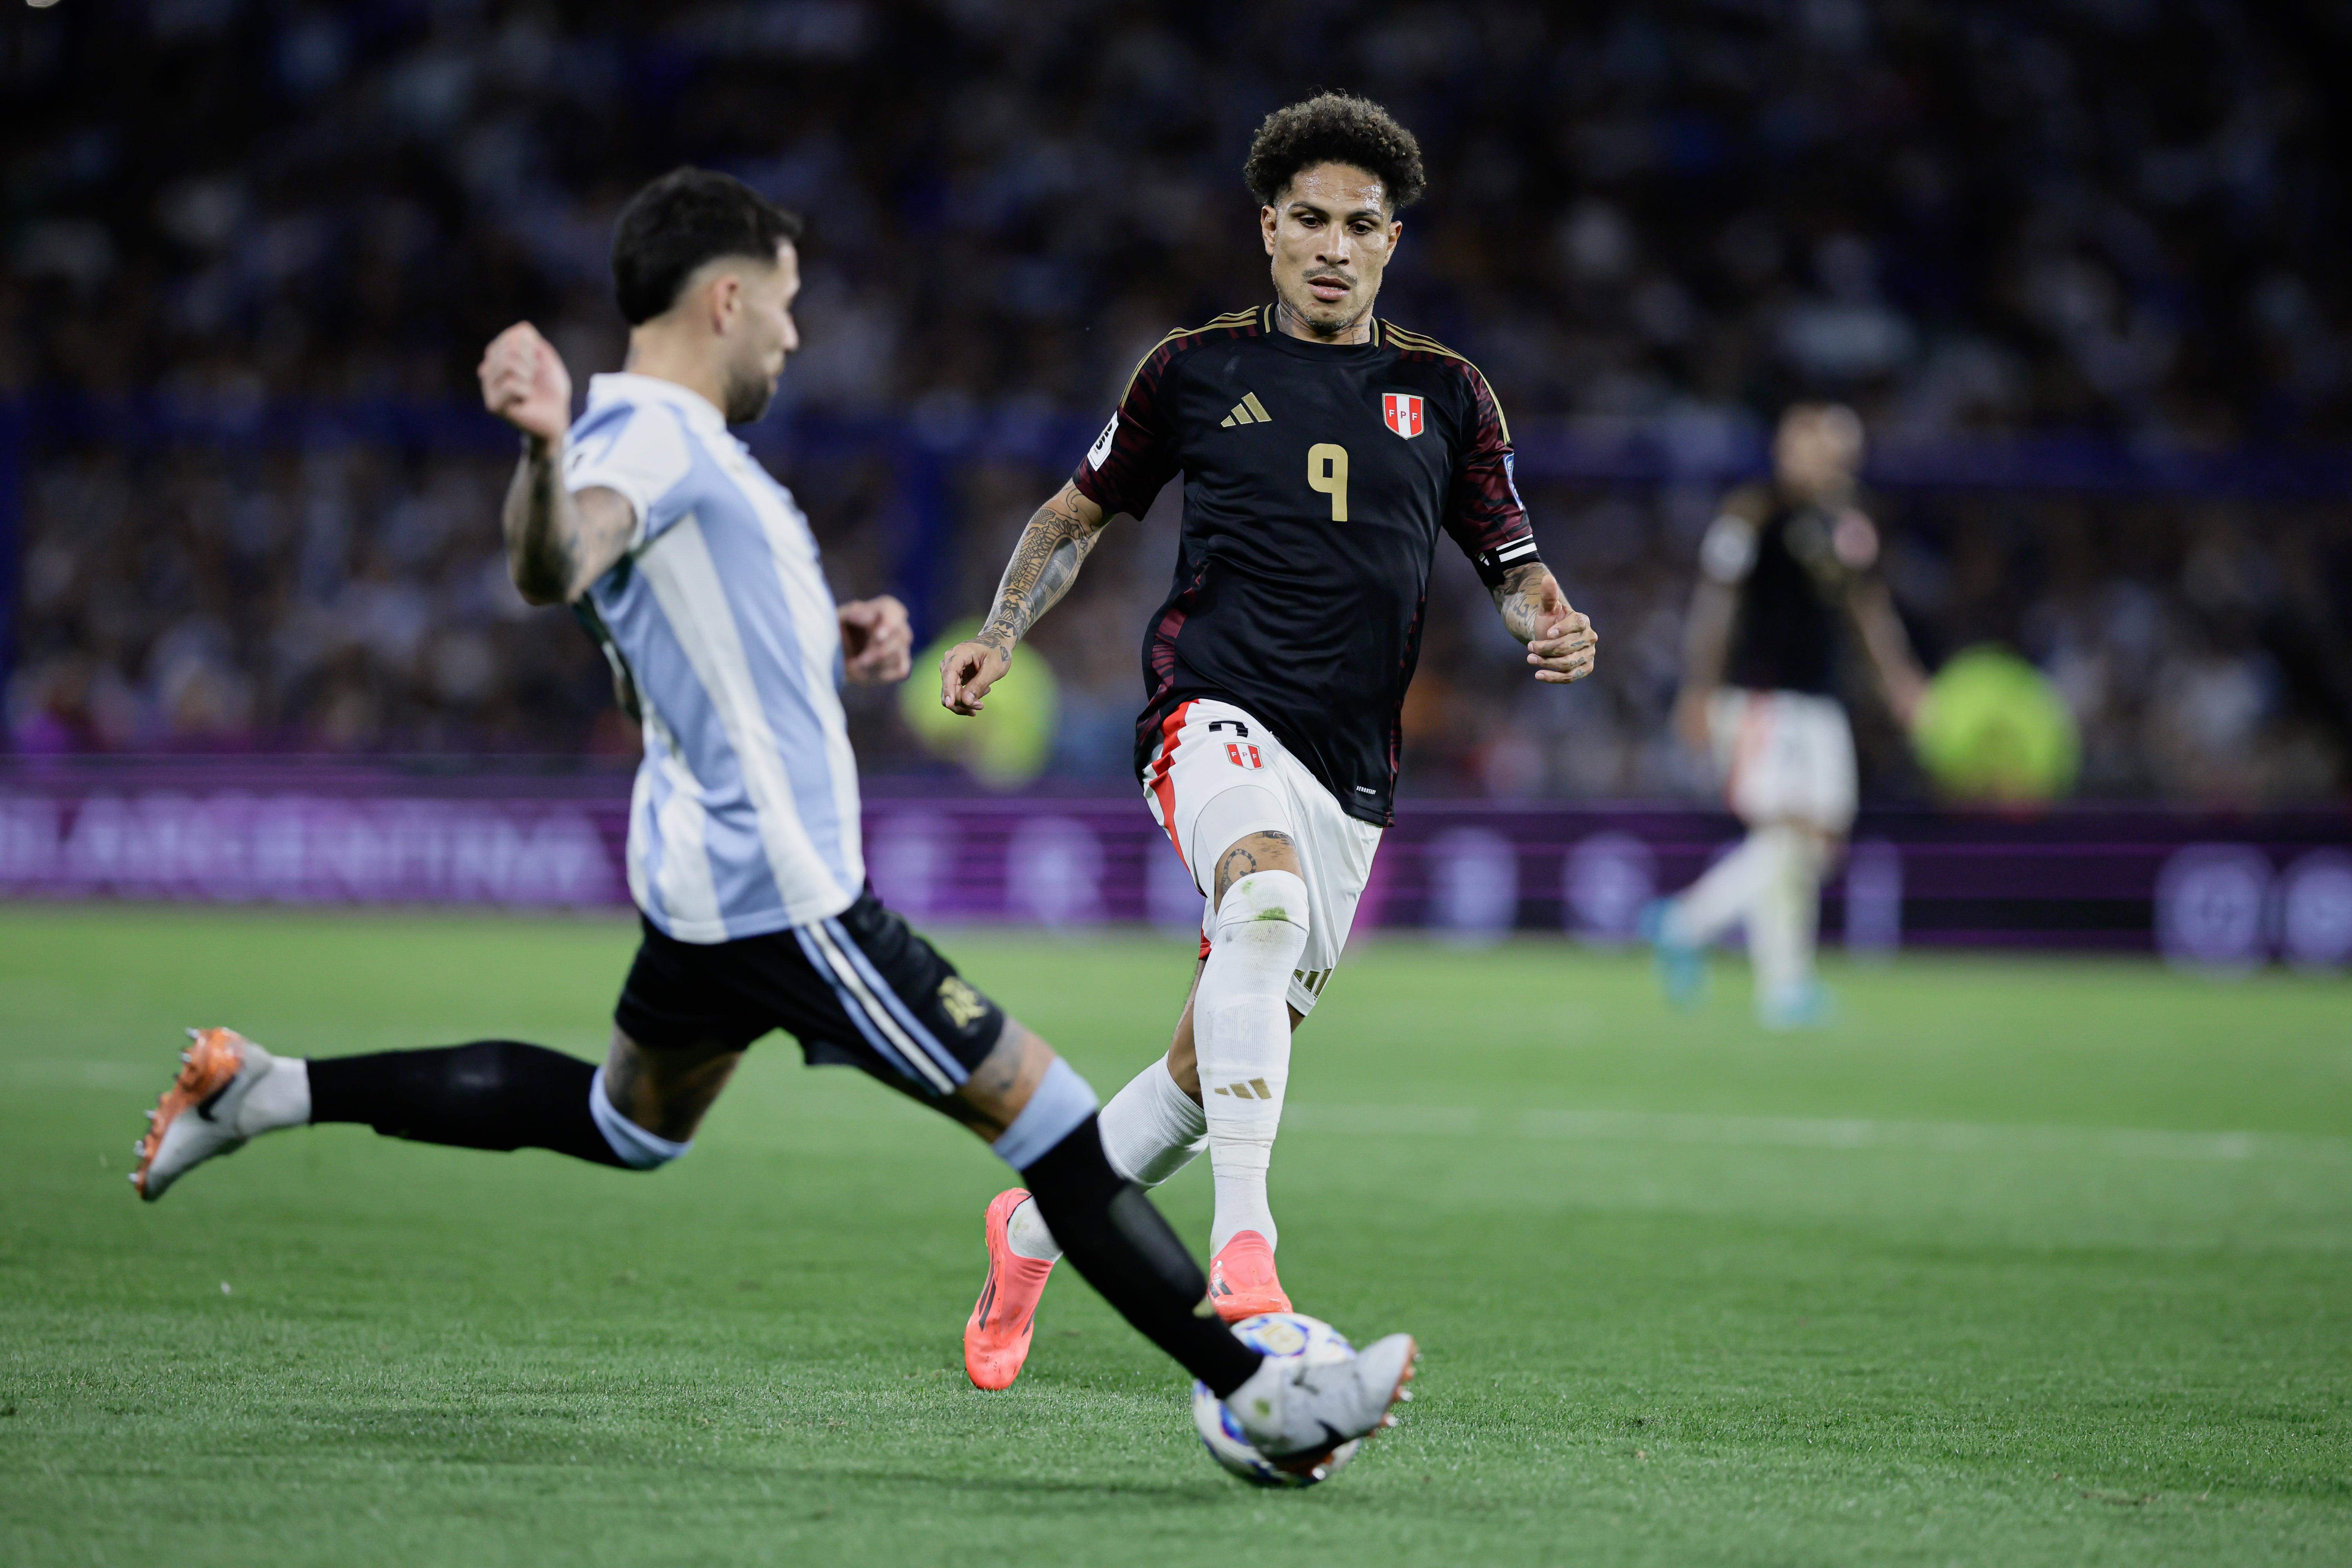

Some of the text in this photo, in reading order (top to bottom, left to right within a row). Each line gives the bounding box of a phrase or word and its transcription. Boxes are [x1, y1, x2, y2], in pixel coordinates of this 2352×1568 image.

[1388, 409, 1418, 421] FPF
[1308, 443, 1348, 521] 9
[1356, 786, 1376, 795] AEROREADY
